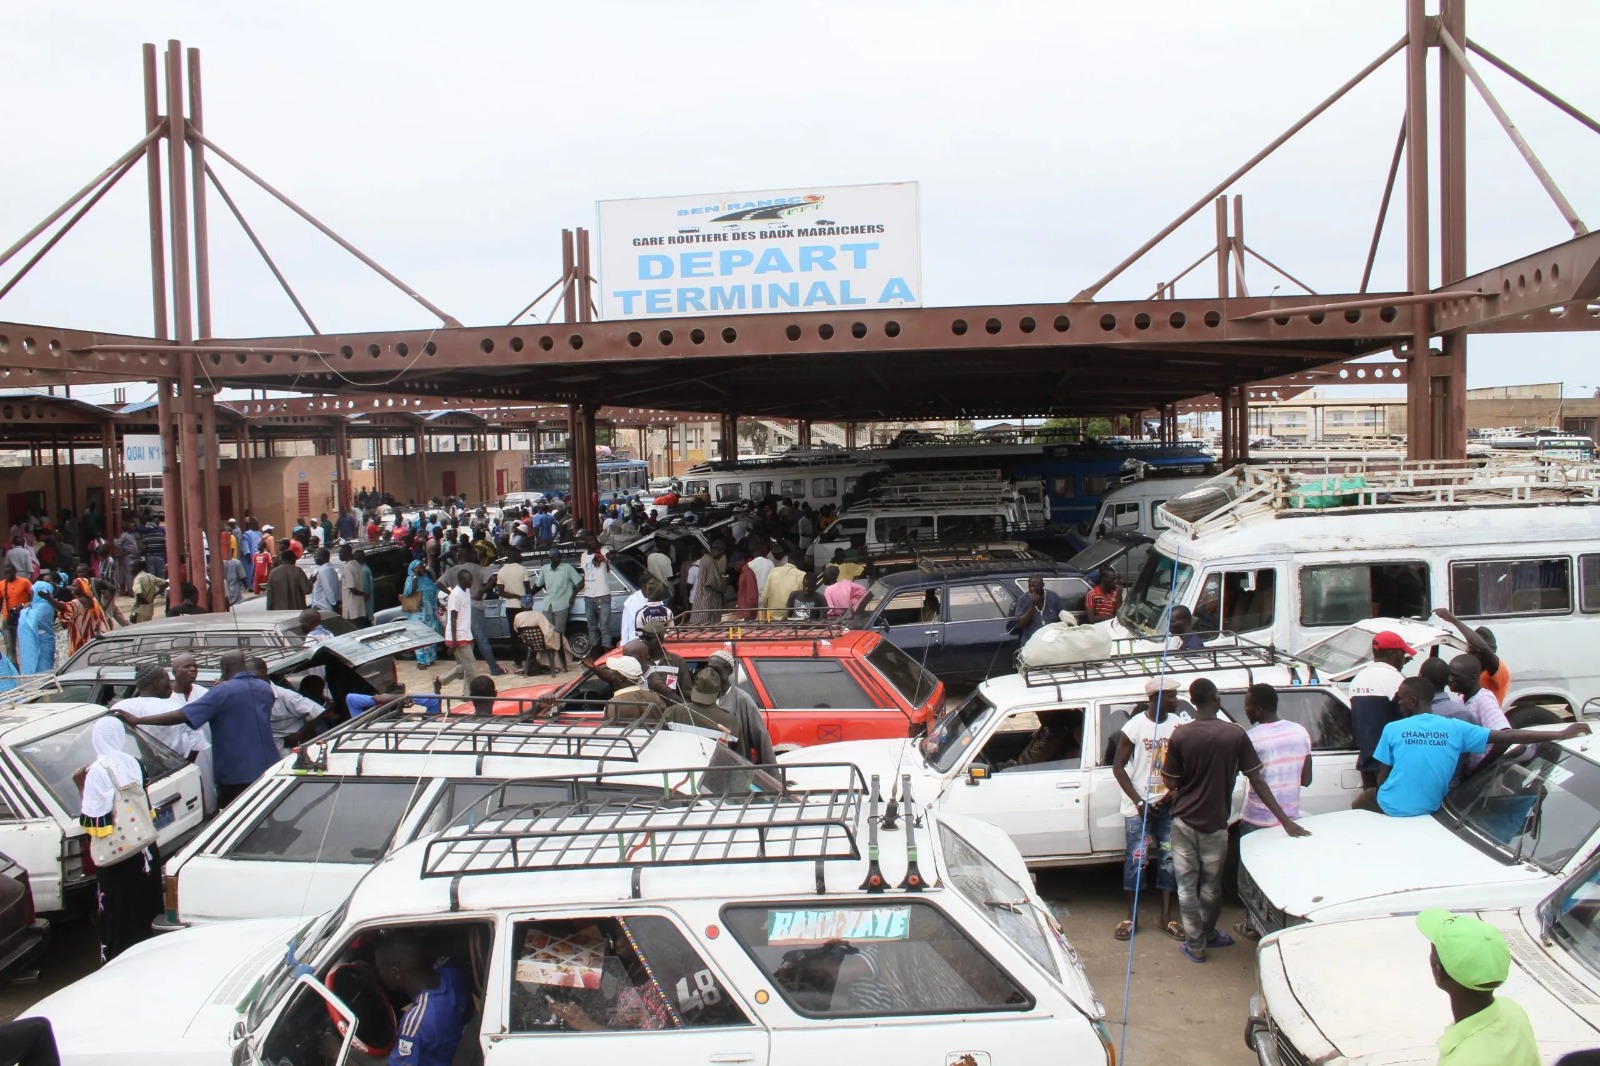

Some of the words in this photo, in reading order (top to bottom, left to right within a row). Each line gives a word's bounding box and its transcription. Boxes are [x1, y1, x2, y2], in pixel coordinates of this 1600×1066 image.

[632, 237, 665, 247] GARE
[667, 233, 729, 245] ROUTIERE
[732, 231, 756, 242] DES
[759, 228, 795, 241] BAUX
[797, 224, 885, 238] MARAICHERS
[637, 242, 880, 281] DEPART
[613, 279, 867, 315] TERMINAL
[877, 277, 917, 304] A
[126, 446, 145, 461] QUAI
[1401, 731, 1449, 739] CHAMPIONS
[1404, 738, 1428, 746] SENIOR
[1428, 739, 1447, 747] CLASS
[675, 968, 722, 1014] 48
